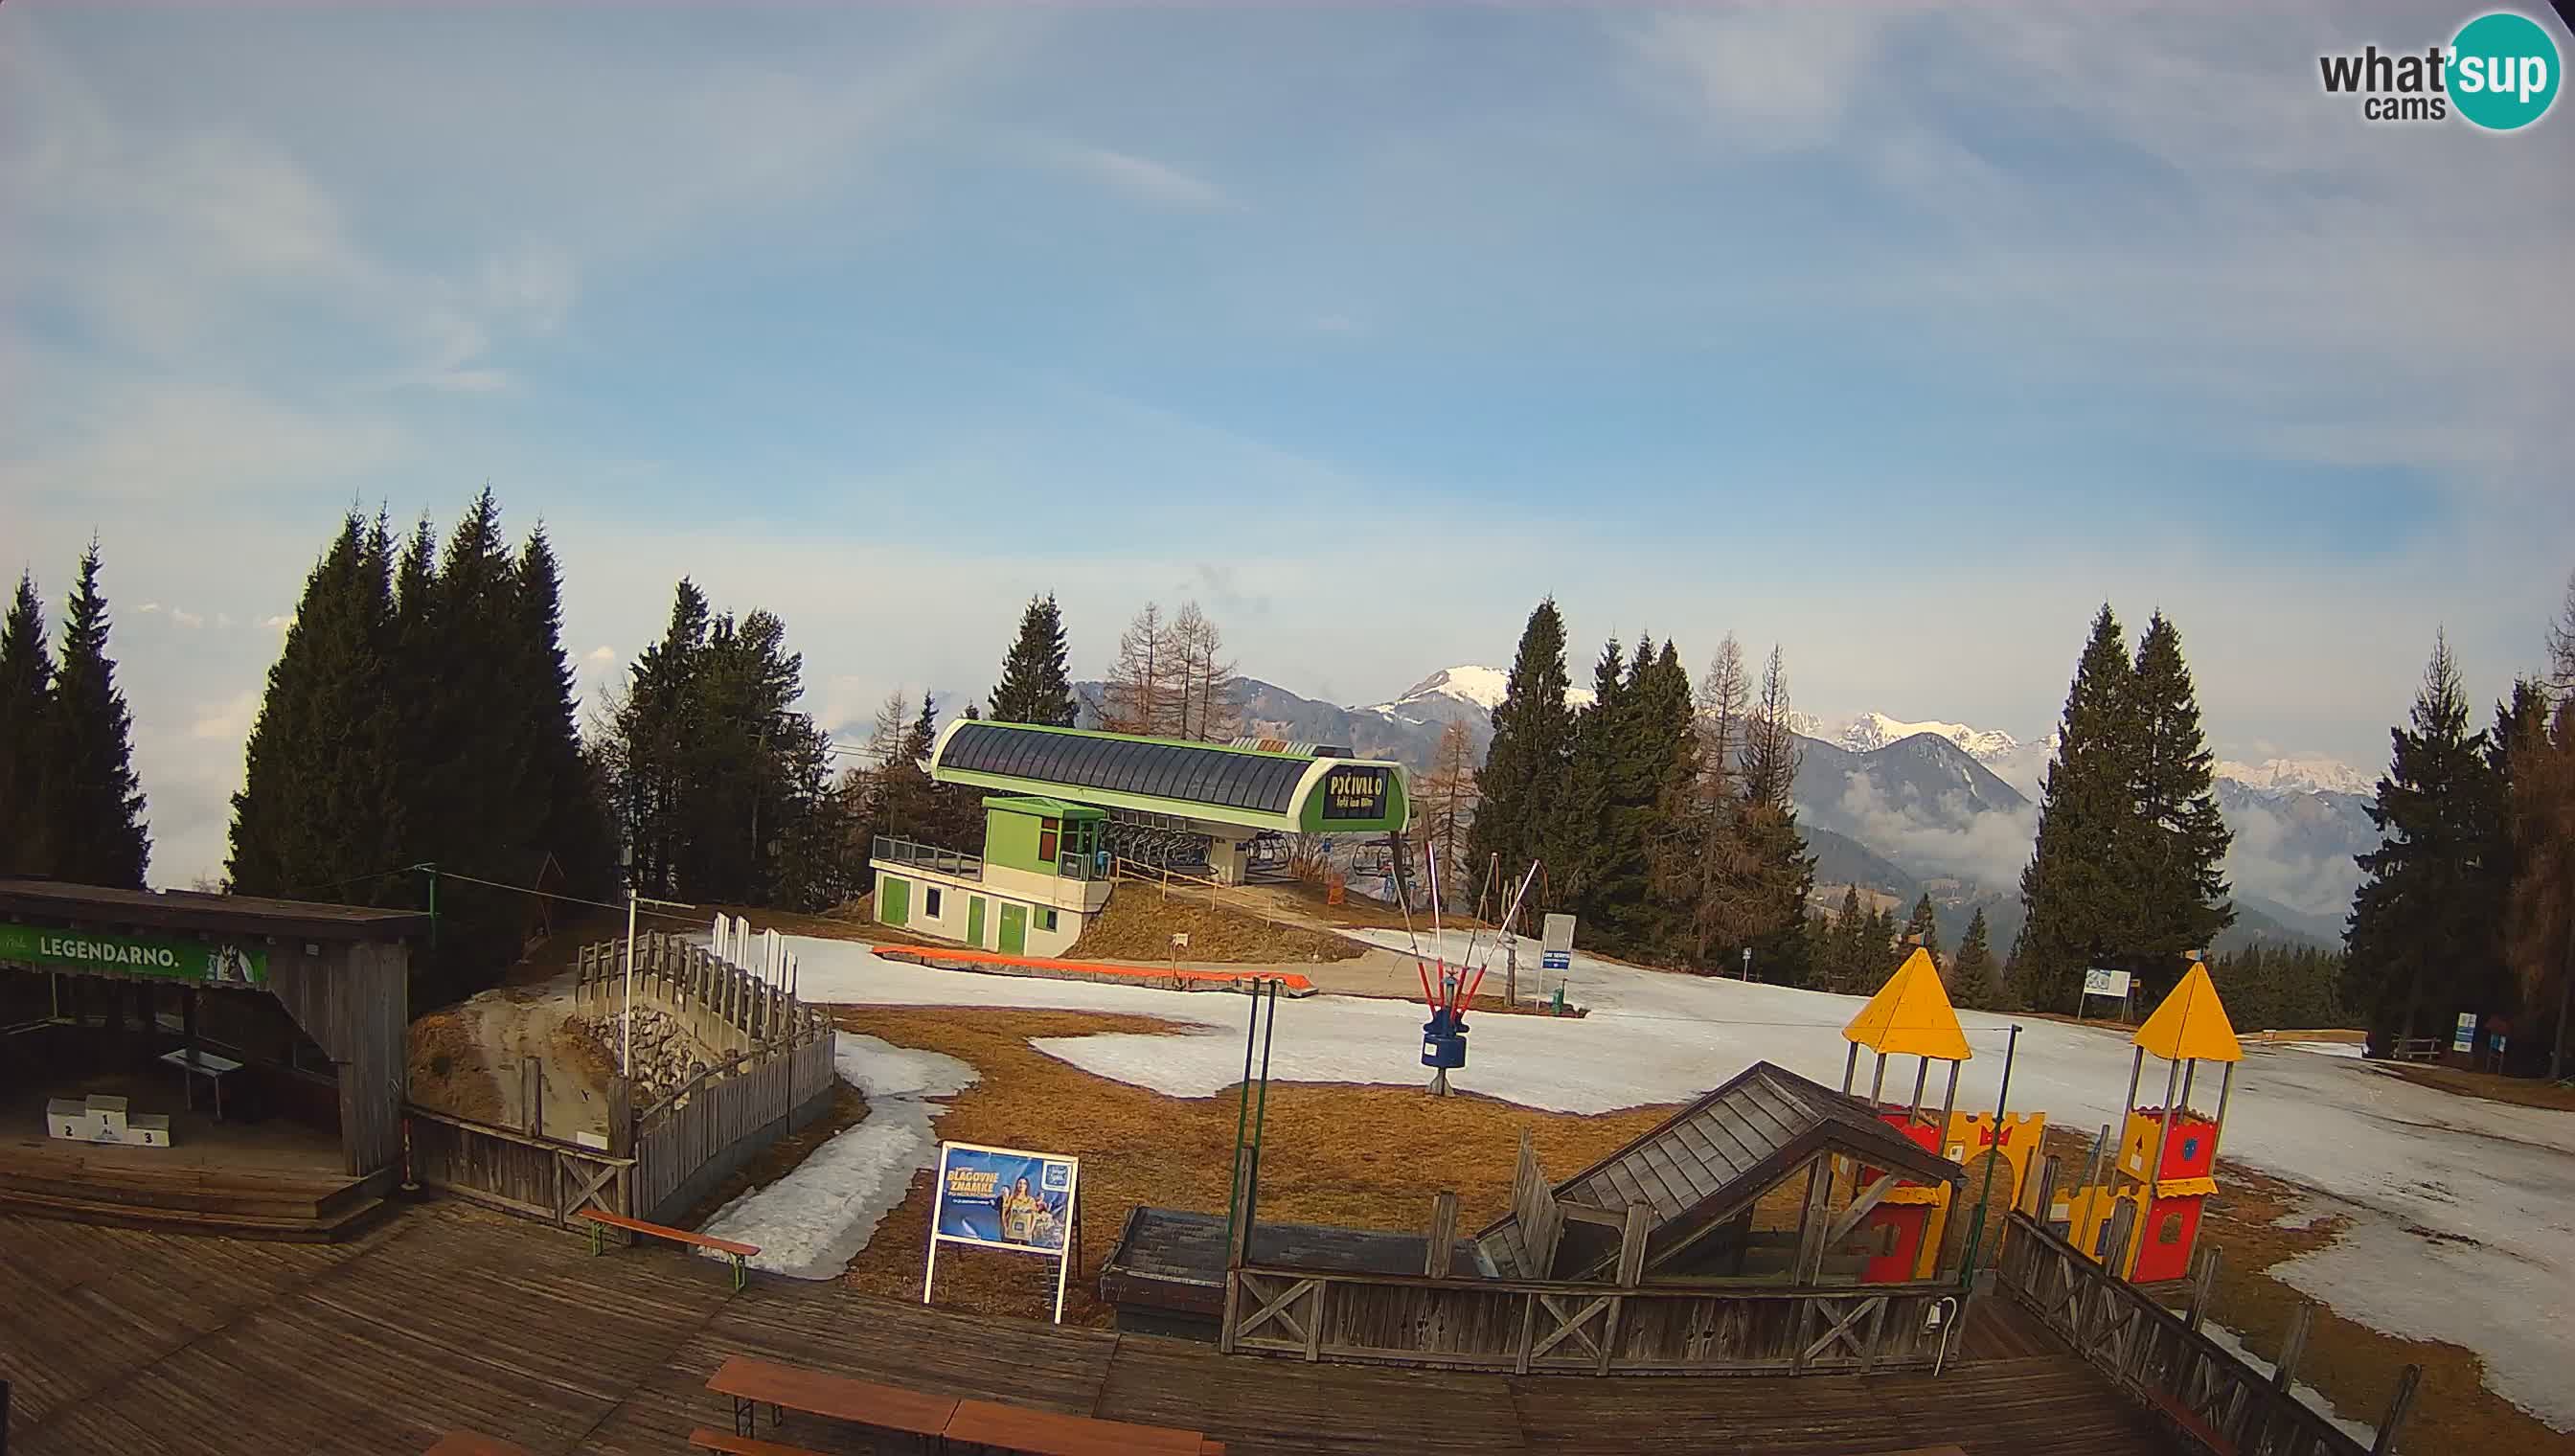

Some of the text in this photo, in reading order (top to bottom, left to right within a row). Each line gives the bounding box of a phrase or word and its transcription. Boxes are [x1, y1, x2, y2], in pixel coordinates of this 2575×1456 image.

[40, 937, 180, 967] LEGENDARNO.
[102, 1114, 108, 1126] 1
[65, 1126, 74, 1137] 2
[145, 1132, 153, 1144] 3
